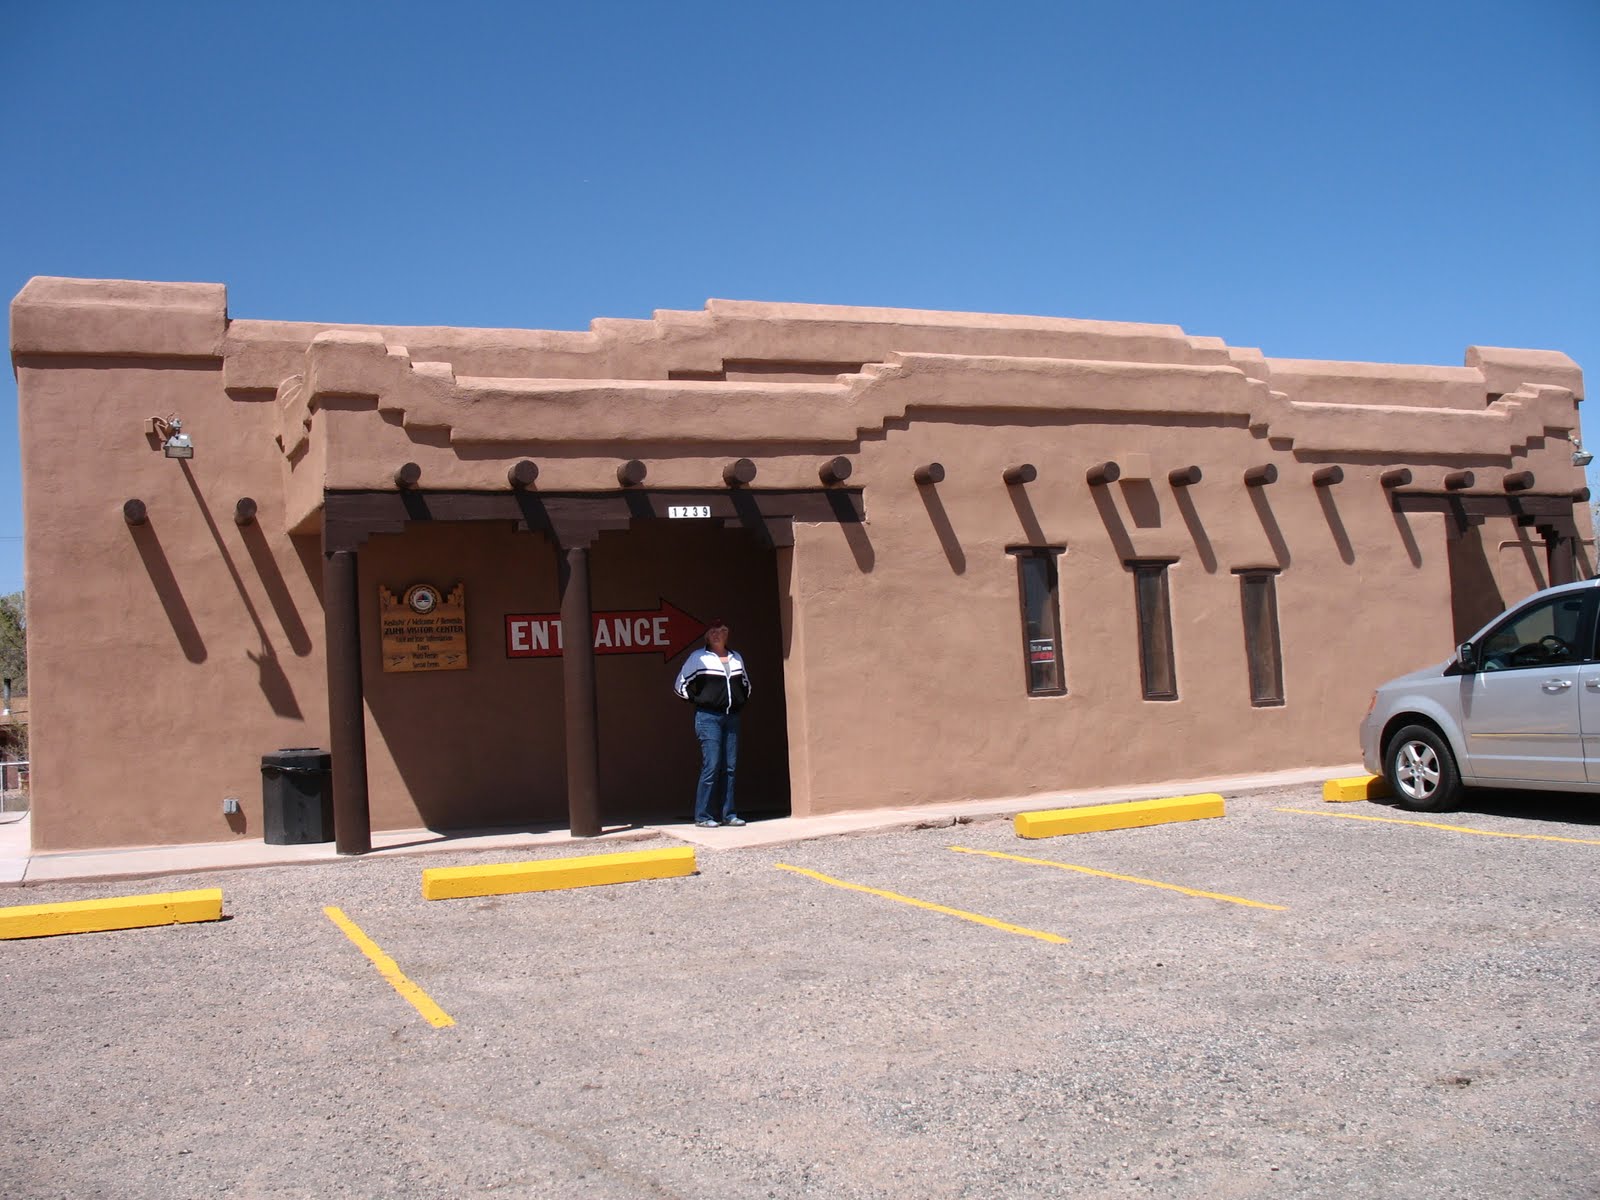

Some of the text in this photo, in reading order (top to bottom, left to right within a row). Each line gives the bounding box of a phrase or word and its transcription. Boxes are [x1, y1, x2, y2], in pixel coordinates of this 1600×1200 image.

[673, 506, 708, 517] 1239
[407, 626, 433, 634] VISITOR
[436, 625, 464, 633] CENTER
[510, 617, 670, 651] ENTANCE
